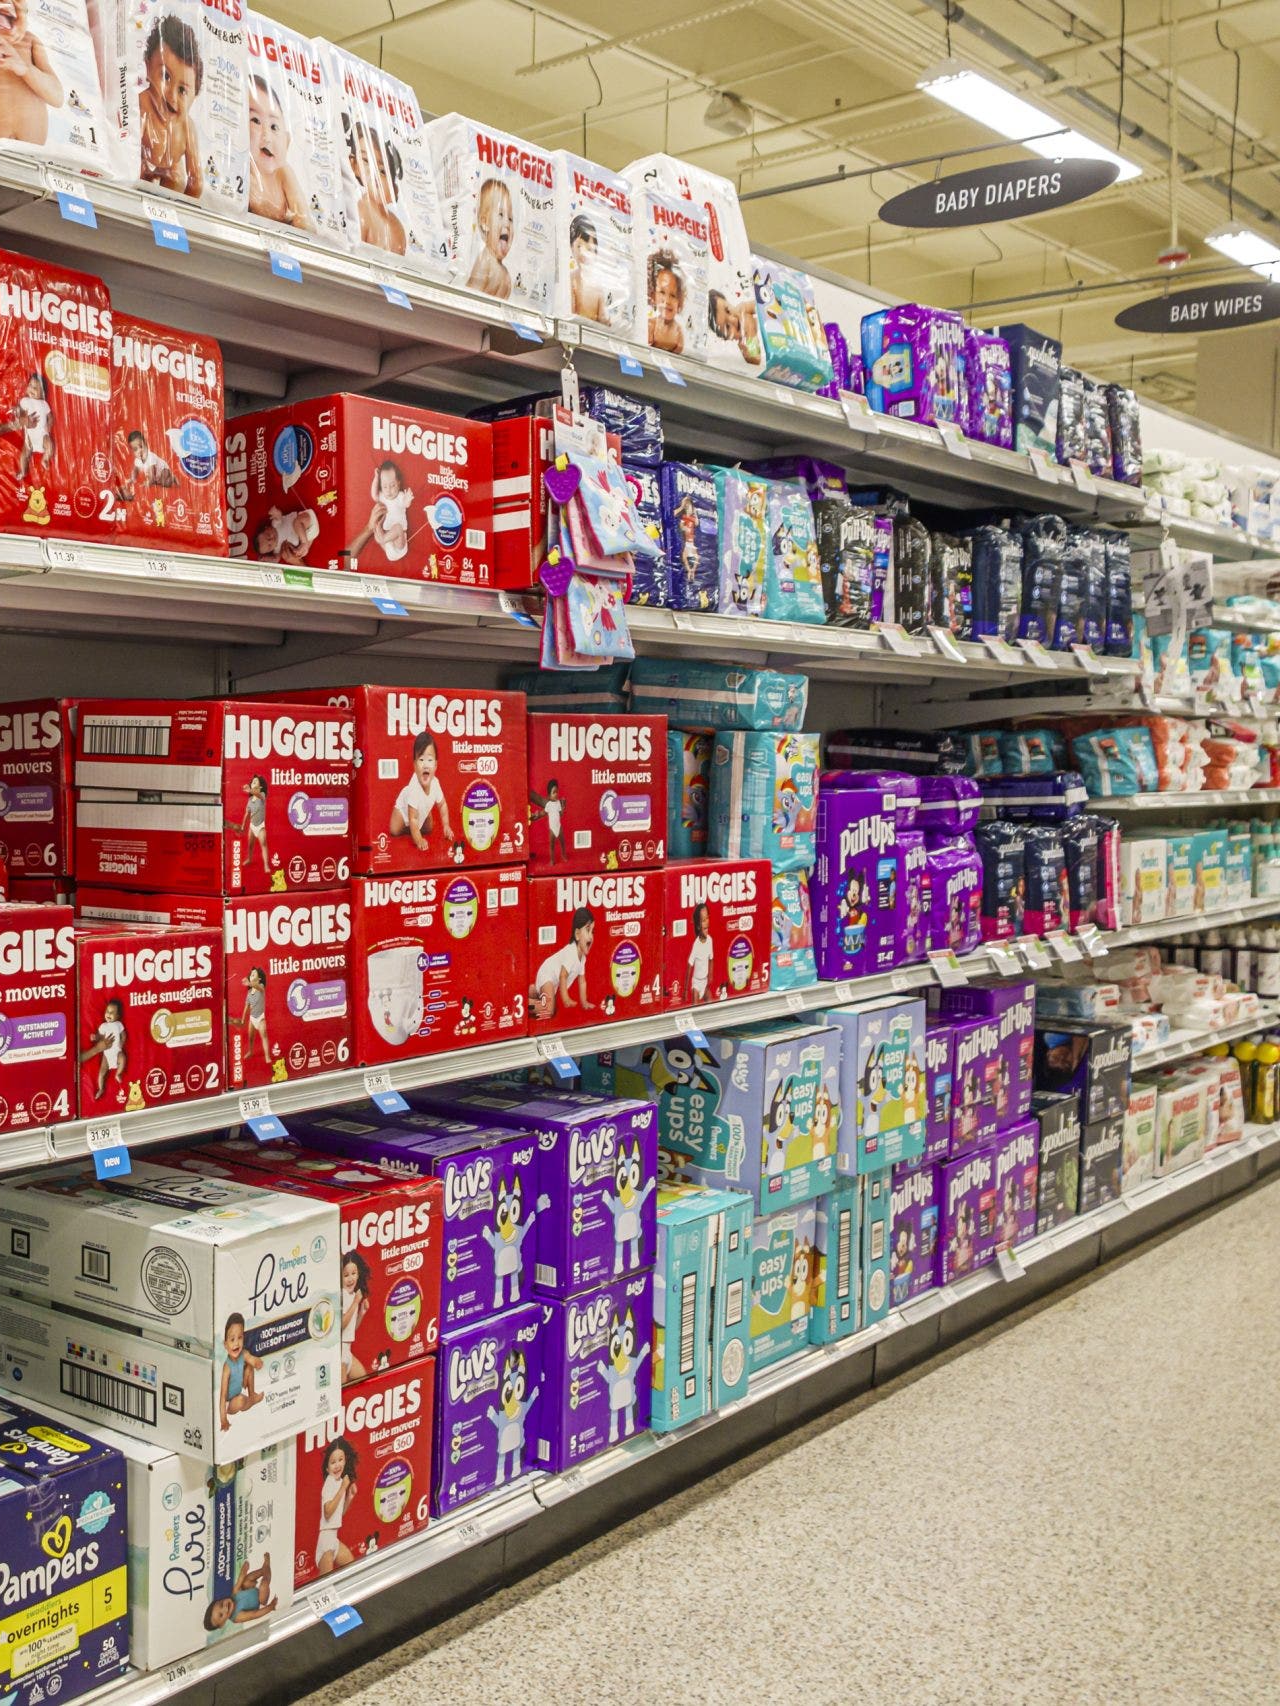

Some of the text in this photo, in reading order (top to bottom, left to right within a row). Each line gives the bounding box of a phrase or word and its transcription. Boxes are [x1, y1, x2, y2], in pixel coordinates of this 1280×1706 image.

[476, 134, 553, 189] HUGGIES
[574, 170, 633, 215] HUGGIES
[935, 173, 1061, 214] BABY DIAPERS
[68, 203, 85, 216] new
[147, 205, 167, 219] 10.29
[162, 230, 180, 241] new
[653, 205, 708, 242] HUGGIES
[439, 242, 447, 257] 4
[1170, 295, 1262, 322] BABY WIPES
[113, 335, 218, 387] HUGGIES
[372, 416, 468, 466] HUGGIES
[427, 472, 468, 490] snugglers
[676, 471, 717, 501] HUGGIES
[98, 490, 115, 521] 2
[462, 558, 473, 570] 84
[265, 573, 282, 584] 11.39
[387, 692, 503, 737] HUGGIES
[225, 714, 354, 762] HUGGIES
[550, 722, 651, 762] HUGGIES
[2, 760, 52, 775] movers
[271, 769, 350, 786] little movers
[796, 773, 811, 785] easy
[800, 785, 813, 795] ups
[514, 822, 524, 847] 3
[656, 840, 664, 859] 4
[364, 878, 437, 907] HUGGIES
[556, 875, 645, 914] HUGGIES
[681, 870, 757, 908] HUGGIES
[225, 903, 351, 954] HUGGIES
[93, 946, 212, 989] HUGGIES
[338, 1038, 349, 1062] 6
[53, 1088, 69, 1117] 4
[667, 1097, 685, 1142] ups
[688, 1094, 705, 1153] easy
[104, 1155, 120, 1167] new
[341, 1201, 431, 1255] UGGIES
[278, 1254, 307, 1273] Pampers
[759, 1252, 787, 1277] easy
[249, 1254, 310, 1318] Pure
[761, 1277, 784, 1297] ups
[426, 1318, 437, 1344] 6
[370, 1417, 420, 1444] little movers
[417, 1494, 428, 1521] 6
[104, 1587, 113, 1604] 5
[313, 1594, 330, 1611] 31.99
[7, 1600, 80, 1645] overnights
